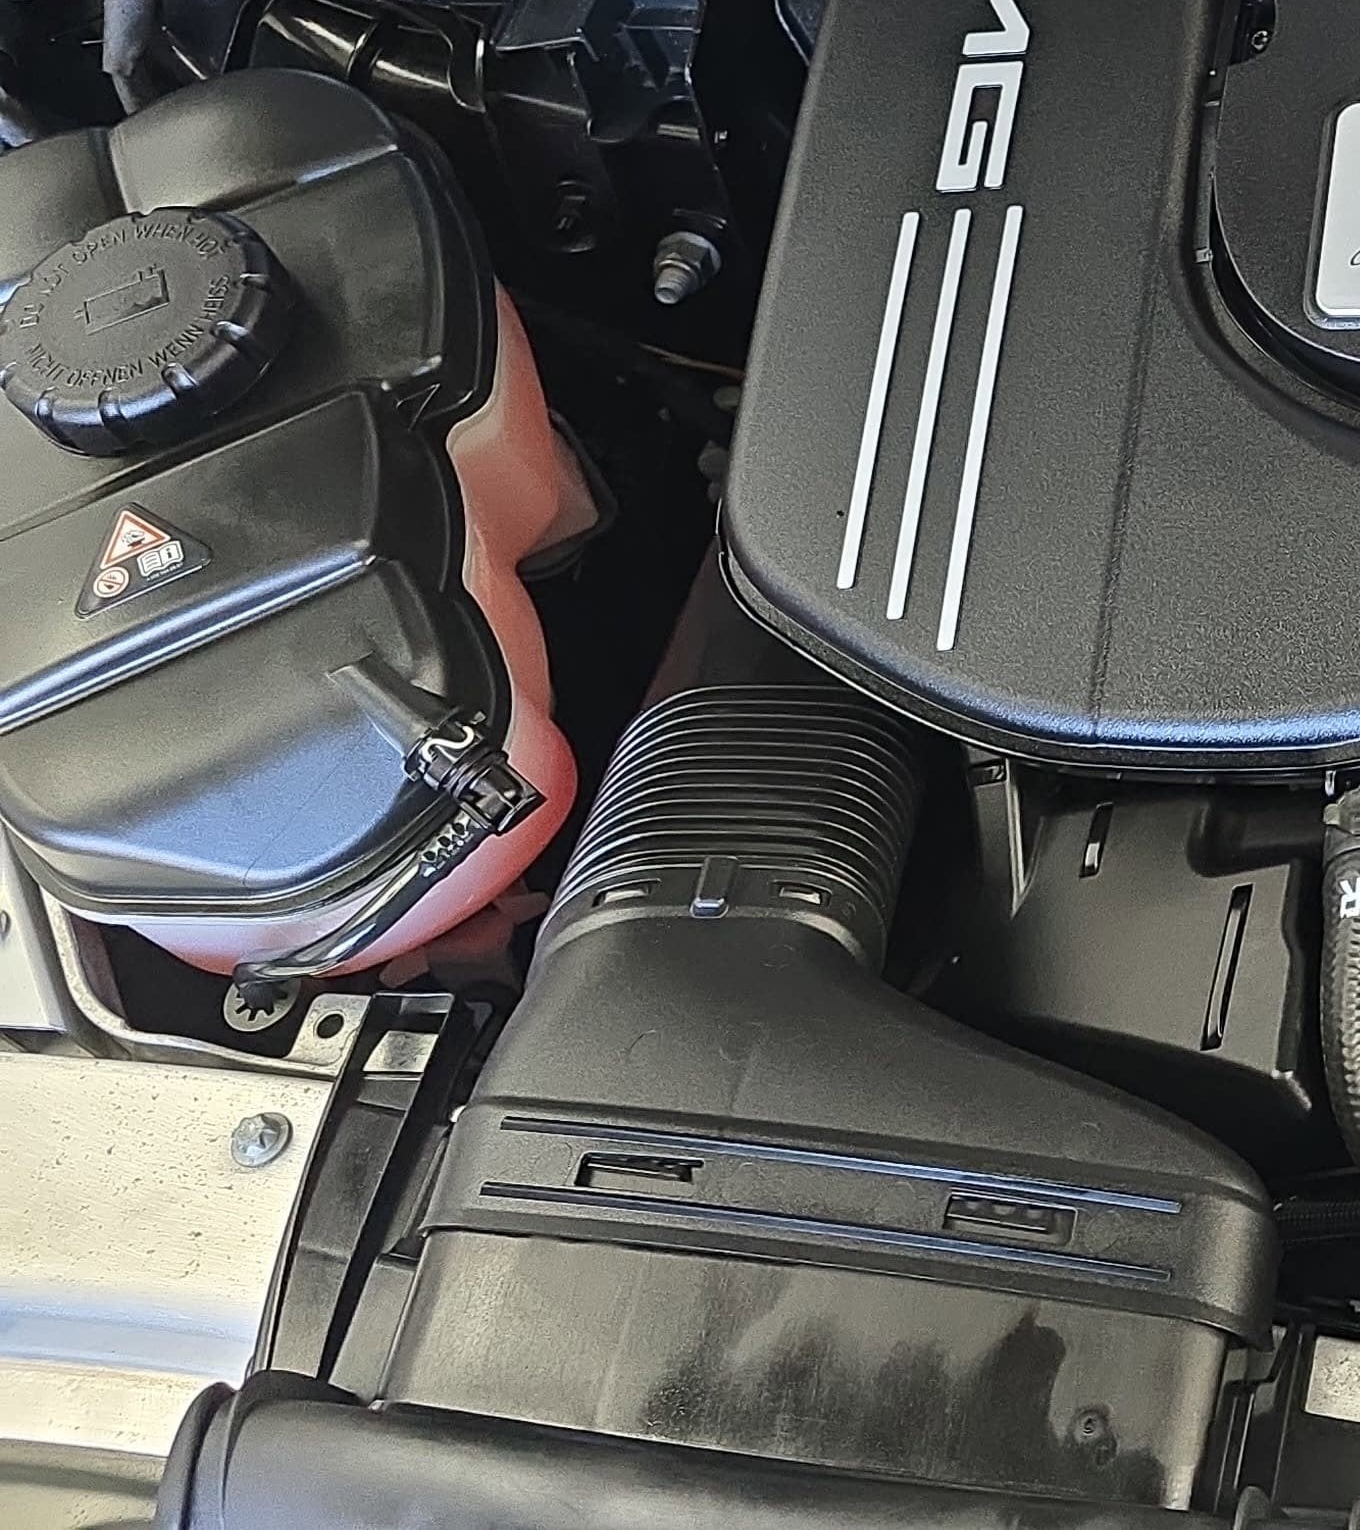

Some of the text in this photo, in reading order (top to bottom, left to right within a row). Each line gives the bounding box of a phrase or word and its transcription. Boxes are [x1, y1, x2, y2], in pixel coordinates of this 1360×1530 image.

[72, 229, 126, 265] OPEN
[134, 222, 194, 243] WHEN
[148, 323, 205, 368] WENN
[200, 274, 231, 322] HEISS
